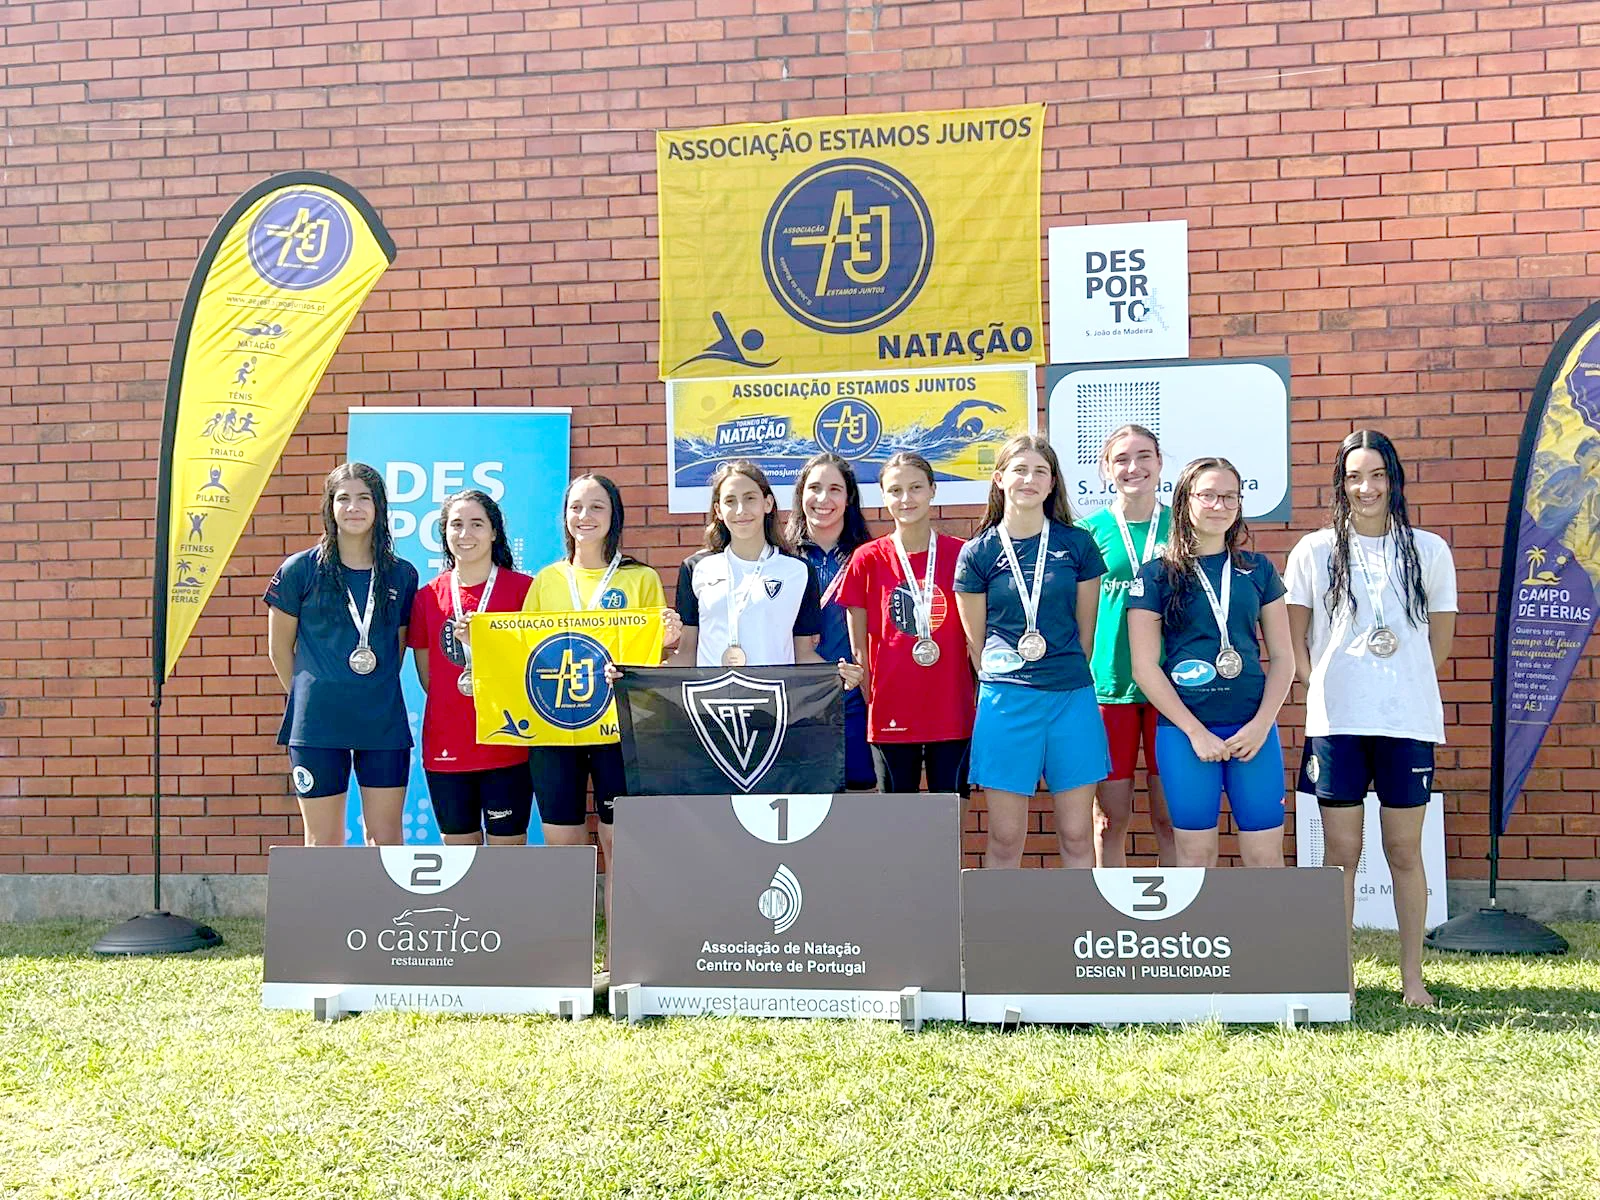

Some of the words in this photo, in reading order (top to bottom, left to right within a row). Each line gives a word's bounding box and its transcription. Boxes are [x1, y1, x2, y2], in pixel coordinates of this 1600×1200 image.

[668, 127, 813, 161] ASSOCIAÇÃO
[820, 125, 930, 152] ESTAMOS
[937, 117, 1032, 145] JUNTOS
[1086, 249, 1146, 273] DES
[858, 287, 885, 295] JUNTOS
[1086, 275, 1148, 299] POR
[237, 339, 275, 350] NATAÇÃO
[878, 323, 1033, 361] NATAÇÃO
[228, 390, 252, 400] TÉNIS
[732, 382, 830, 400] ASSOCIAÇÃO
[836, 379, 910, 395] ESTAMOS
[915, 377, 976, 392] JUNTOS
[736, 418, 758, 427] TORNEIO
[719, 420, 785, 444] NATAÇÃO
[210, 448, 244, 457] TRIATLO
[1078, 480, 1093, 494] S.
[196, 494, 231, 503] PILATES
[180, 544, 214, 553] FITNESS
[1519, 588, 1570, 602] CAMPO
[1518, 604, 1536, 616] DE
[1540, 601, 1591, 620] FÉRIAS
[489, 616, 554, 630] ASSOCIAÇÃO
[557, 617, 605, 628] ESTAMOS
[608, 615, 647, 626] JUNTOS
[1515, 627, 1541, 635] Queres
[1511, 638, 1542, 648] campo
[1544, 637, 1556, 646] de
[1515, 660, 1532, 668] Tens
[769, 798, 788, 841] 1
[410, 853, 443, 886] 2
[1132, 876, 1168, 911] 3
[1359, 884, 1376, 895] da
[346, 929, 367, 951] O
[1073, 930, 1232, 960] deBastos
[701, 940, 780, 957] Associação
[783, 941, 800, 954] de
[804, 942, 861, 957] Natação
[391, 956, 454, 967] restaurante
[696, 958, 742, 972] Centro
[745, 959, 782, 972] Norte
[785, 960, 803, 972] de
[807, 960, 866, 976] Portugal
[1075, 965, 1126, 978] DESIGN
[1141, 965, 1231, 978] PUBLICIDADE
[374, 993, 464, 1007] MEALHADA
[657, 994, 900, 1016] www.restauranteocastico.p
